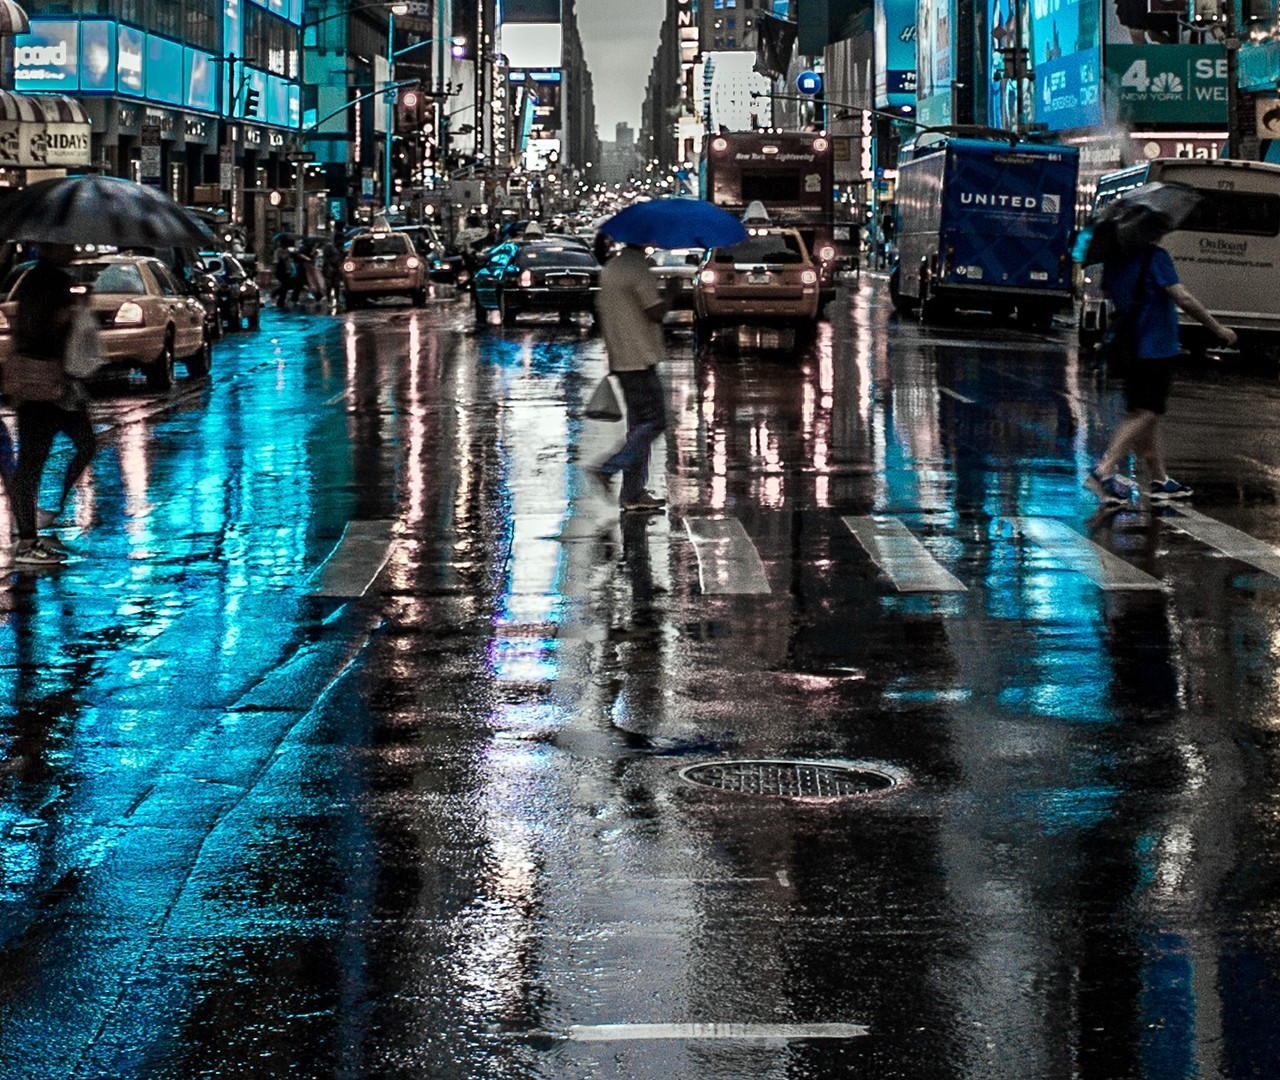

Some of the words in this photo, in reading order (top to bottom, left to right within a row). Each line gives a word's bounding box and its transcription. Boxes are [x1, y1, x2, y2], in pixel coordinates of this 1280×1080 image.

[1120, 59, 1150, 92] 4
[1122, 93, 1147, 101] NEW
[1150, 93, 1180, 101] YORK
[47, 133, 88, 149] RIDAY'S
[960, 192, 1037, 209] UNITED
